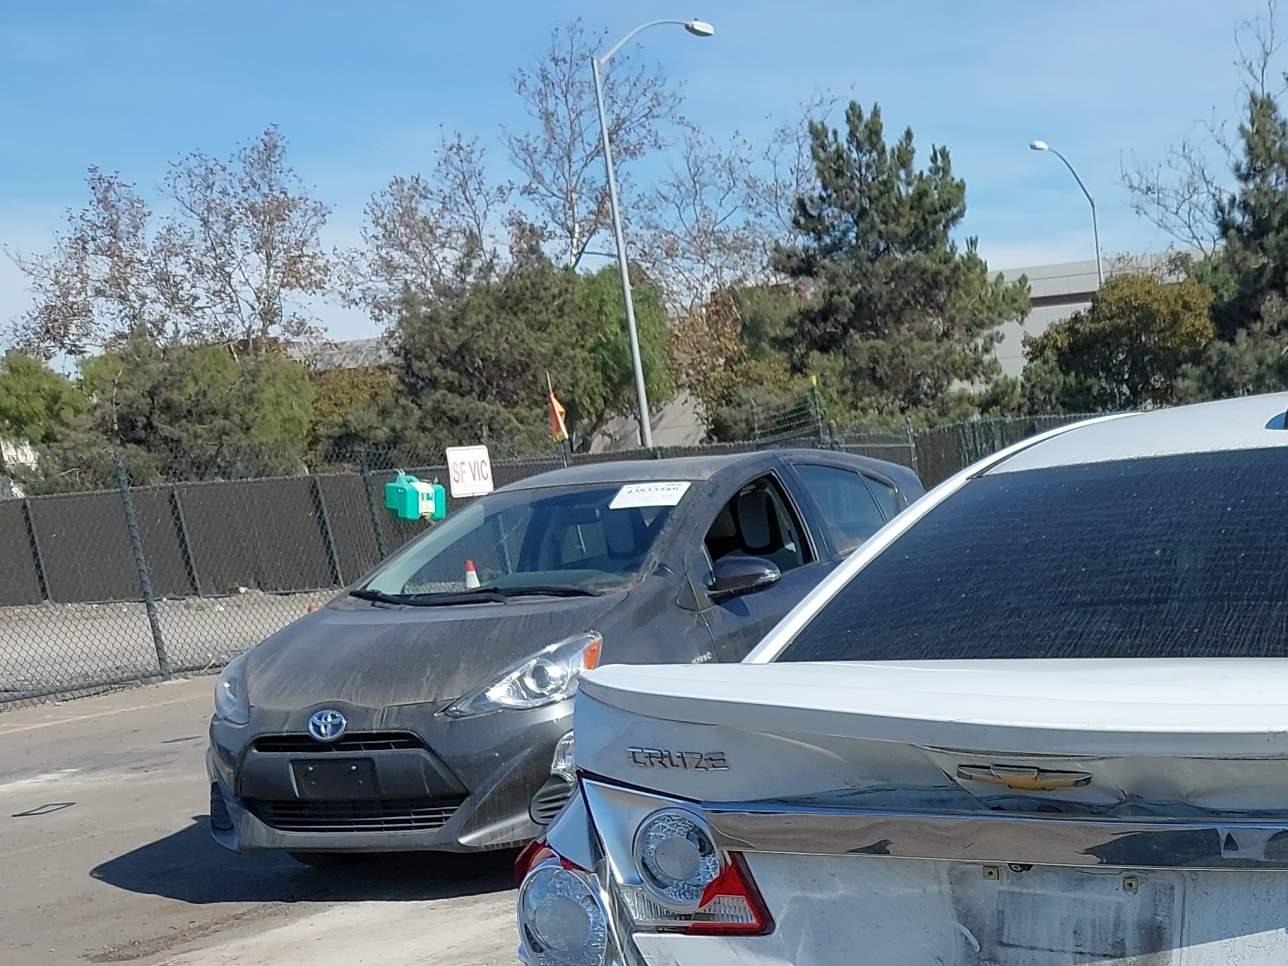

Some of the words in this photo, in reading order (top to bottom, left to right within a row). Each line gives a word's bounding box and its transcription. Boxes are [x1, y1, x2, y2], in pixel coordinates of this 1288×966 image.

[452, 460, 467, 483] SF
[468, 459, 489, 481] VIC
[625, 746, 729, 771] CRUZE
